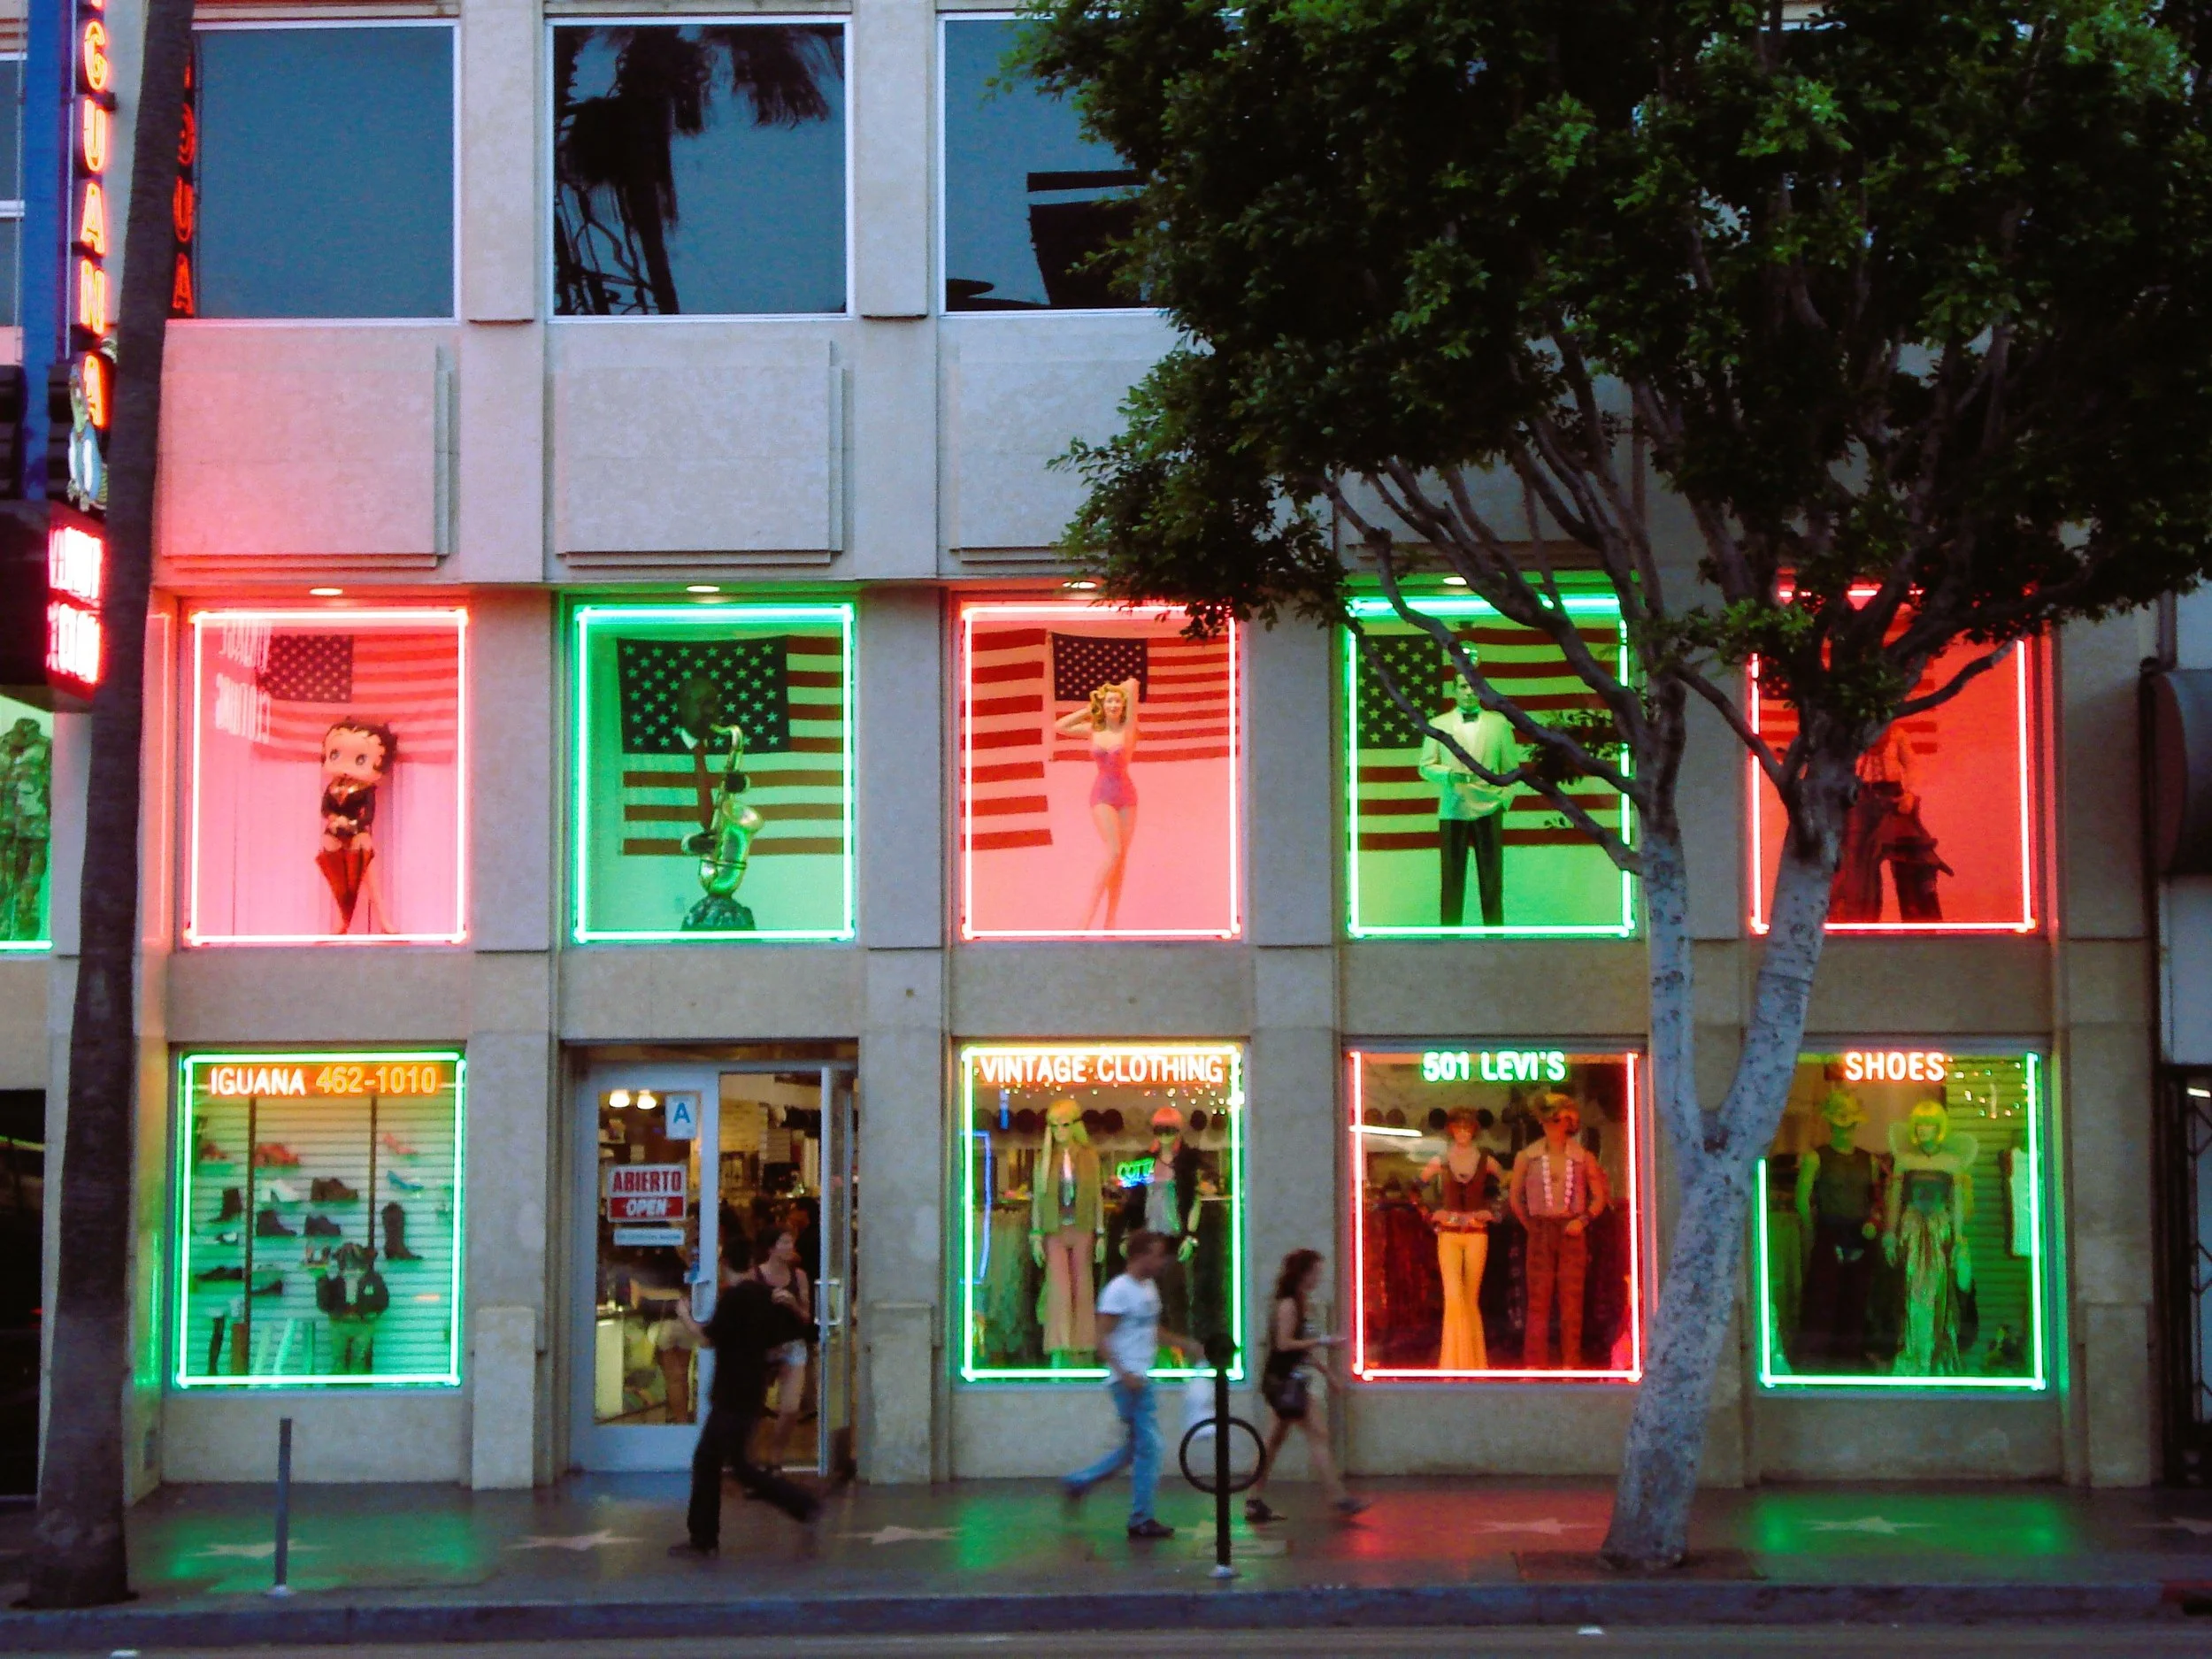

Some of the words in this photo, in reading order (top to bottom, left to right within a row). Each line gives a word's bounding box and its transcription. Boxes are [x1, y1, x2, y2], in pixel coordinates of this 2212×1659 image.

[80, 0, 108, 427] GUANA
[980, 1055, 1087, 1083] VINTAGE
[1096, 1055, 1224, 1083] CLOTHING
[1423, 1051, 1470, 1082] 501
[1480, 1050, 1566, 1082] LEVI'S
[1845, 1051, 1946, 1081] SHOES
[211, 1067, 306, 1095] IGUANA
[315, 1066, 437, 1094] 462-1010
[673, 1102, 691, 1124] A
[612, 1171, 682, 1193] ABIERTO
[626, 1199, 668, 1217] OPEN
